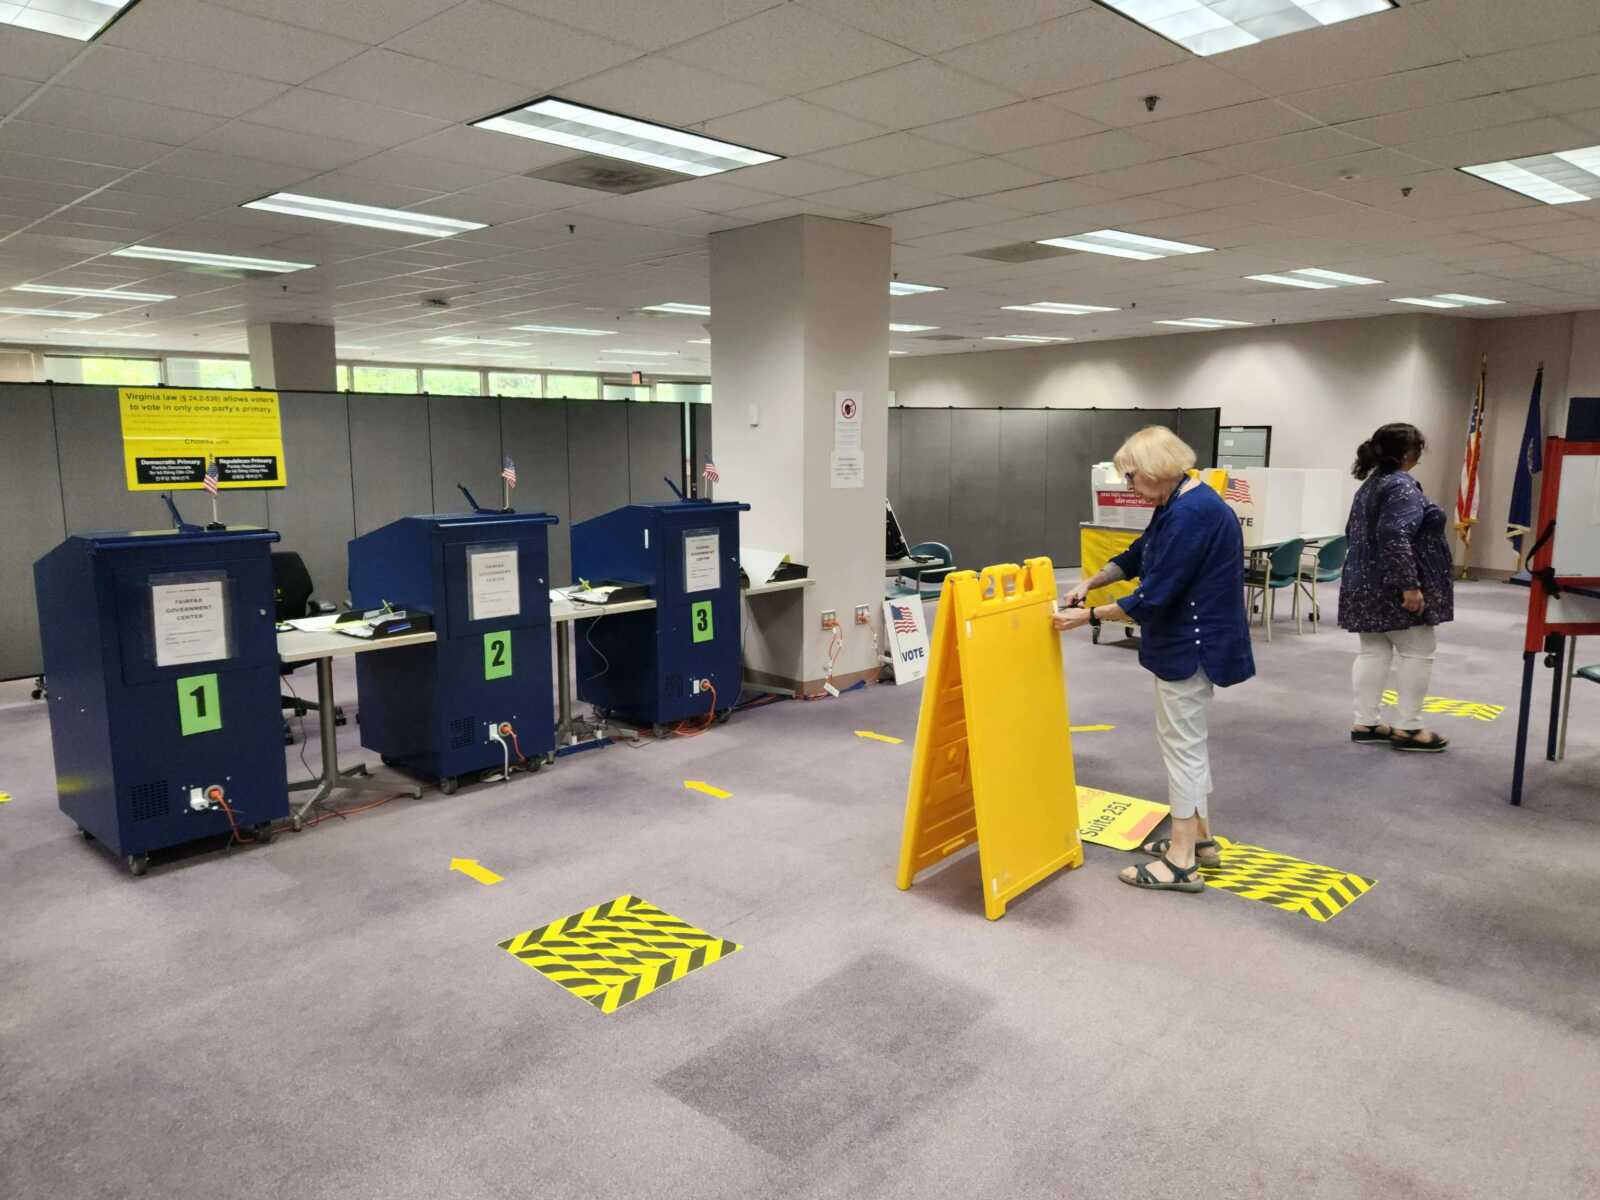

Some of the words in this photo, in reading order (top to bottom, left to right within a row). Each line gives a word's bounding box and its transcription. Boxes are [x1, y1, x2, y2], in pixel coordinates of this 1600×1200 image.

[126, 392, 160, 402] Virginia
[223, 395, 248, 403] allows
[173, 404, 192, 413] only
[212, 405, 240, 414] party's
[1239, 516, 1254, 527] TE
[165, 604, 212, 613] GOVERNMENT
[697, 608, 708, 631] 3
[491, 640, 505, 667] 2
[902, 647, 925, 662] VOTE
[189, 685, 206, 718] 1
[1080, 815, 1116, 837] Suite
[1102, 801, 1132, 816] 251
